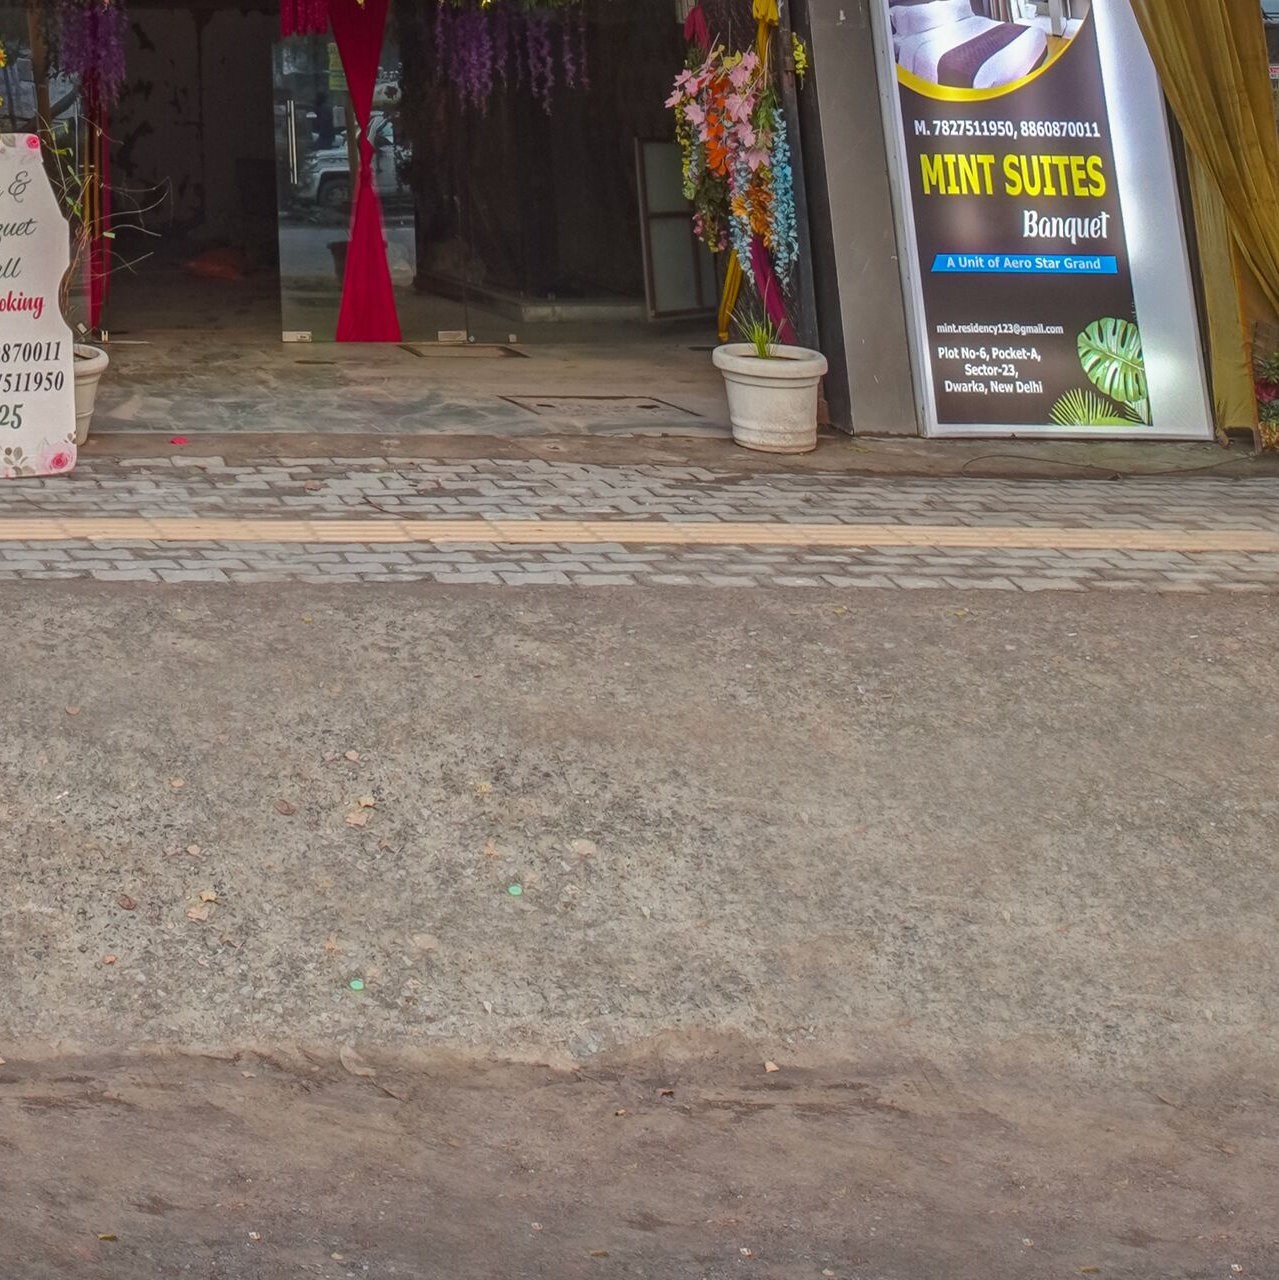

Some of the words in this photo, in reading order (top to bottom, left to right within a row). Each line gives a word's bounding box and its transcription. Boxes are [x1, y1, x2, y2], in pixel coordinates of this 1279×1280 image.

[914, 120, 930, 136] M.
[933, 120, 1017, 139] 7827511950,
[1021, 121, 1101, 137] 8860870011
[920, 154, 995, 195] MINT
[1003, 154, 1106, 197] SUITES
[8, 170, 32, 203] &
[1023, 210, 1110, 245] Banquet
[947, 258, 955, 268] A
[958, 256, 984, 268] Unit
[985, 256, 1000, 268] of
[1003, 257, 1032, 269] Aero
[1035, 257, 1060, 269] Star
[1064, 257, 1101, 269] Grand
[936, 323, 1064, 335] mint.residency123@gmail.com
[938, 347, 959, 359] Plot
[961, 347, 990, 361] No-6,
[991, 347, 1041, 362] Pocket-A,
[964, 363, 1019, 378] Sector-23,
[944, 380, 988, 395] Dwarka,
[990, 381, 1014, 393] New
[1015, 381, 1043, 393] Delhi
